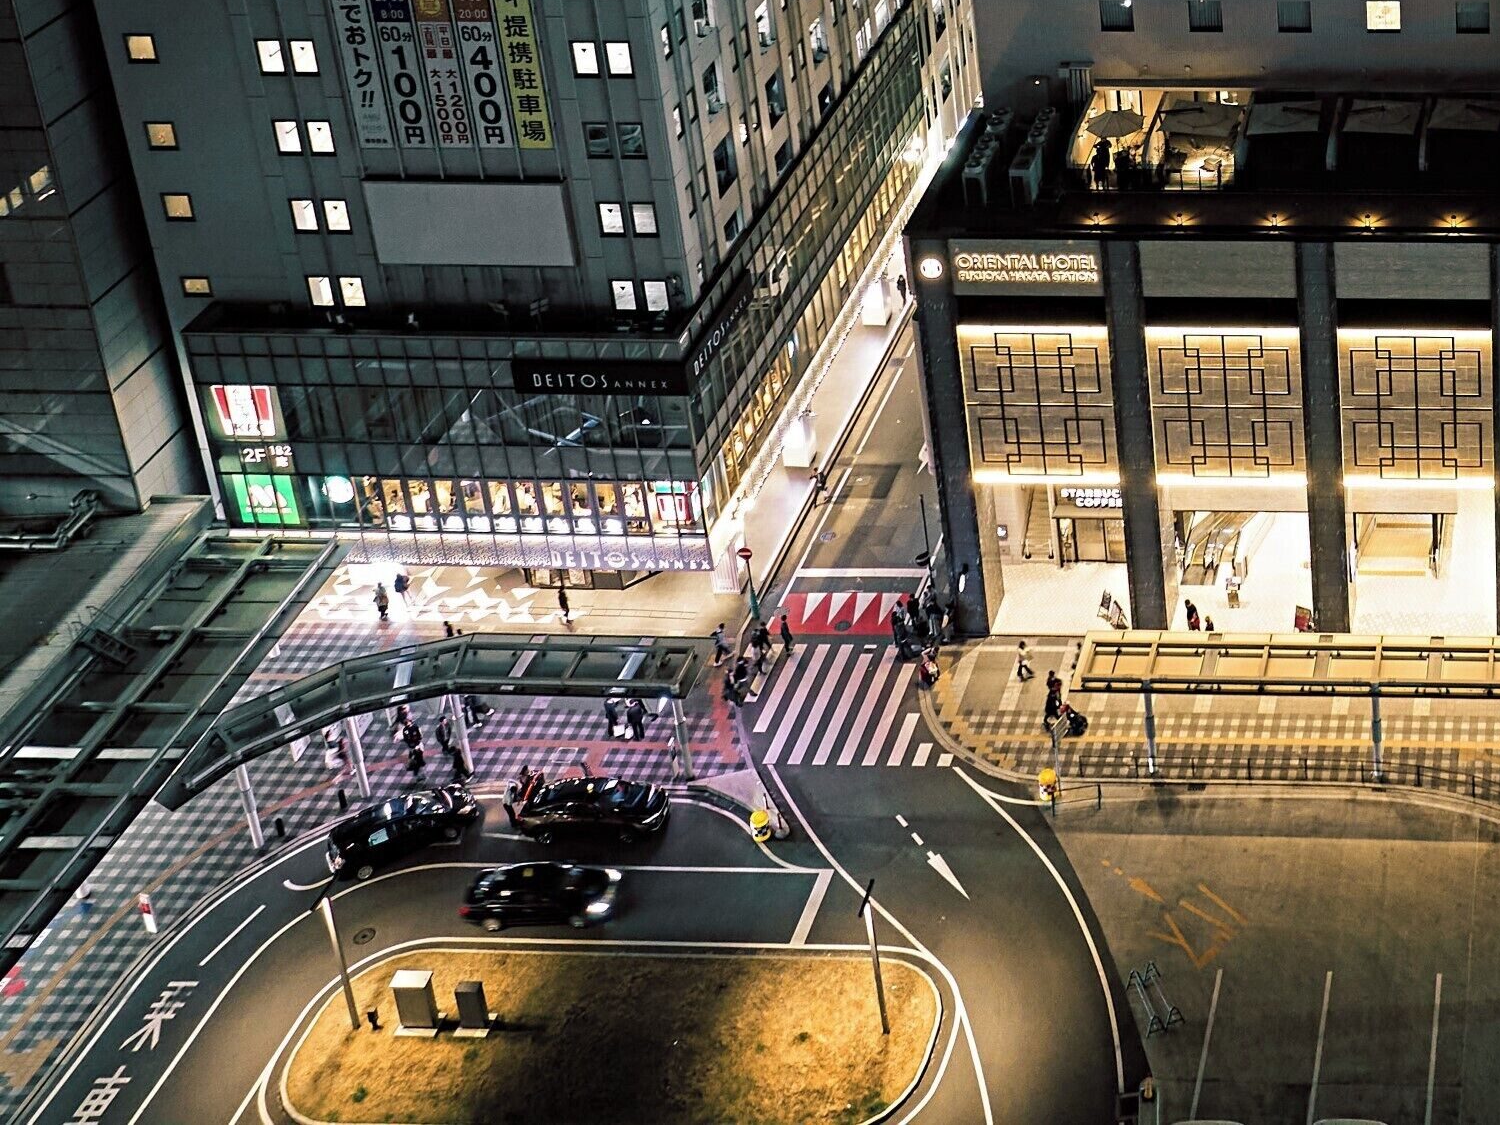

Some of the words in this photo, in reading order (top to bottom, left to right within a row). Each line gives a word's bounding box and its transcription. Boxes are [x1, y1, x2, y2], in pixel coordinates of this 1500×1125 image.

[381, 9, 404, 19] 8:00
[459, 9, 488, 19] 20:00
[380, 26, 413, 43] 60分
[461, 26, 493, 43] 60分
[391, 45, 426, 144] 100円
[470, 45, 505, 144] 400円
[956, 254, 1039, 271] ORIENTAL
[1041, 254, 1099, 271] HOTEL
[958, 271, 1009, 282] FUKUOKA
[1010, 271, 1051, 282] HAKATA
[1052, 271, 1099, 283] STATION
[693, 321, 726, 376] DEITOS
[533, 373, 608, 388] DEITOS
[614, 379, 669, 389] ANNEX
[242, 448, 267, 463] 2F
[1060, 488, 1122, 500] STARBUC
[551, 550, 640, 570] DEITOS
[641, 559, 712, 570] ANNEX
